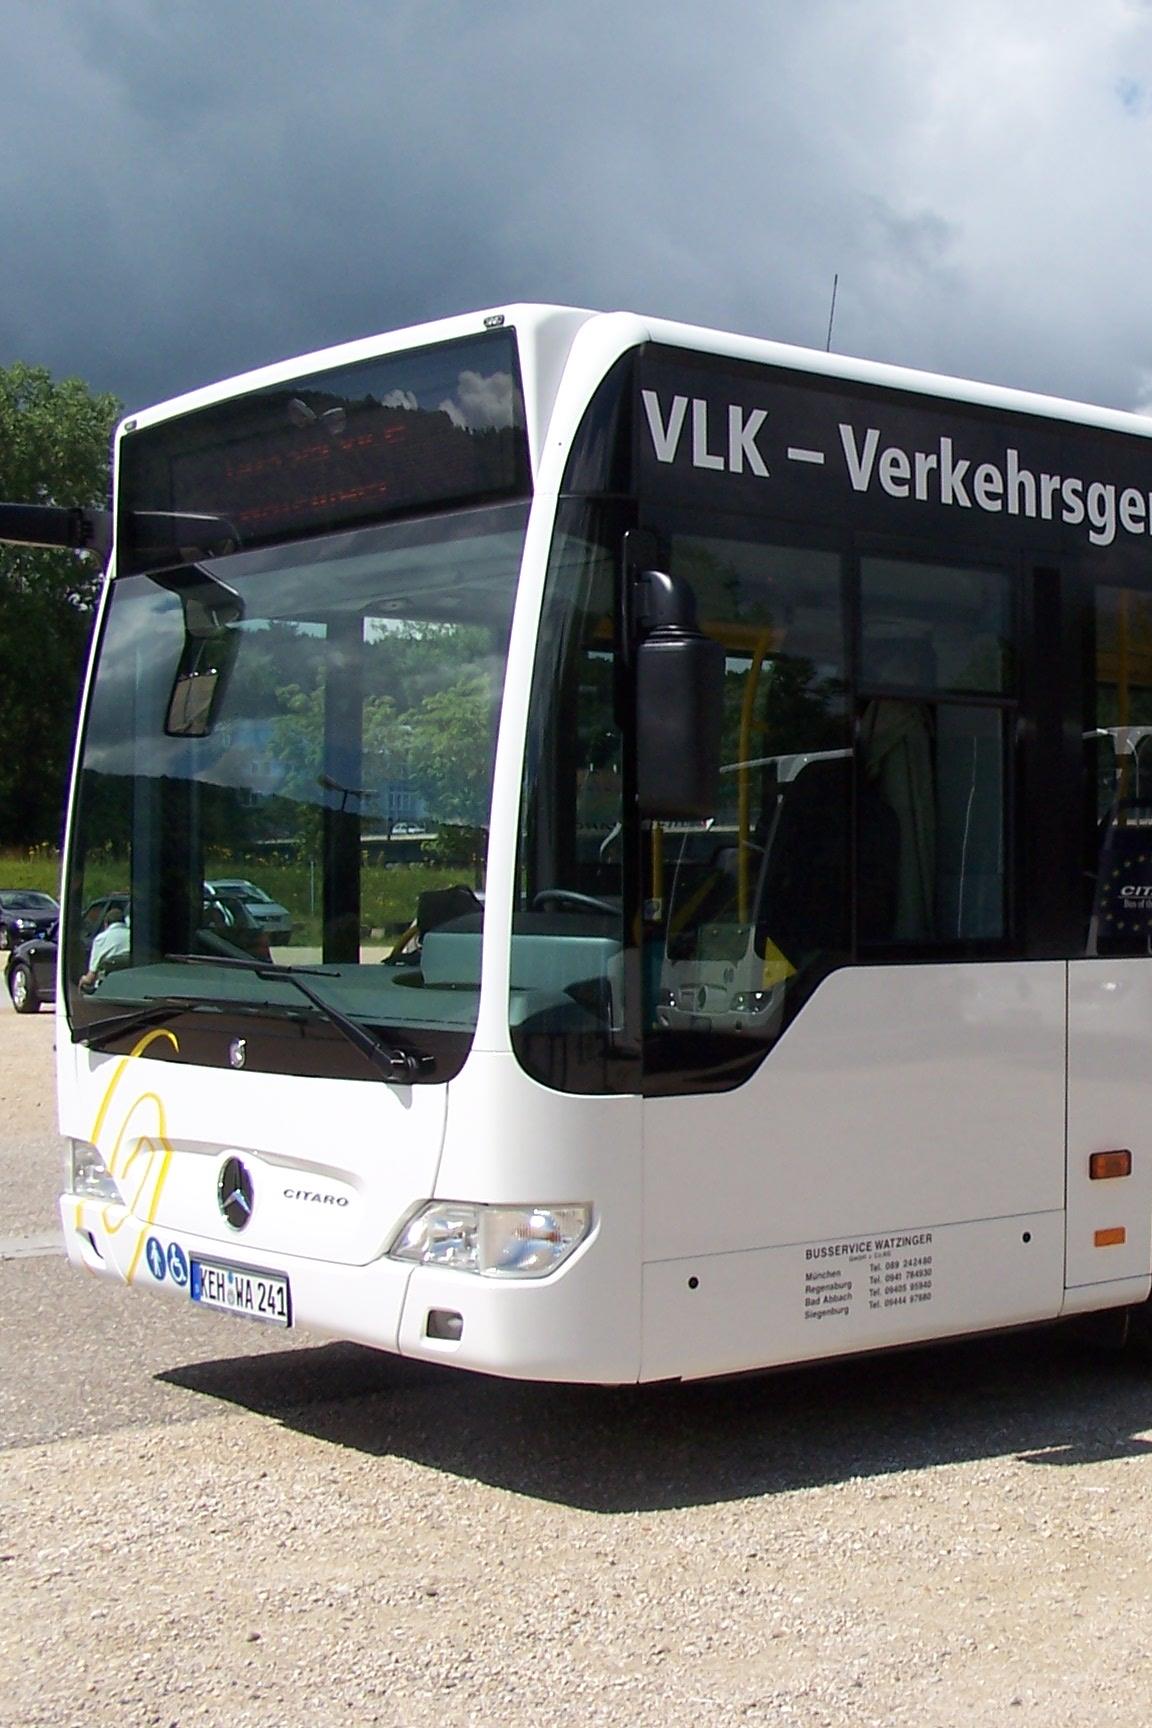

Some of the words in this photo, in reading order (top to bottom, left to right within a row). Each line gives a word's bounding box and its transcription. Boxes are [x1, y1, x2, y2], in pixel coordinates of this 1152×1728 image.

[641, 389, 770, 477] VLK
[283, 1188, 349, 1207] CITARO
[806, 1241, 872, 1260] BUSSERVICE
[875, 1233, 932, 1251] WATZINGER
[806, 1269, 841, 1281] München
[870, 1263, 881, 1272] Tel.
[201, 1268, 225, 1302] KEH
[235, 1276, 254, 1310] WA
[257, 1282, 287, 1316] 241
[805, 1280, 852, 1294] Regensburg
[869, 1275, 881, 1284] Tel.
[805, 1295, 820, 1307] Bad
[823, 1292, 852, 1304] Abbach
[869, 1288, 881, 1297] Tel.
[804, 1306, 849, 1319] Siegenburg
[869, 1300, 881, 1309] Tel.
